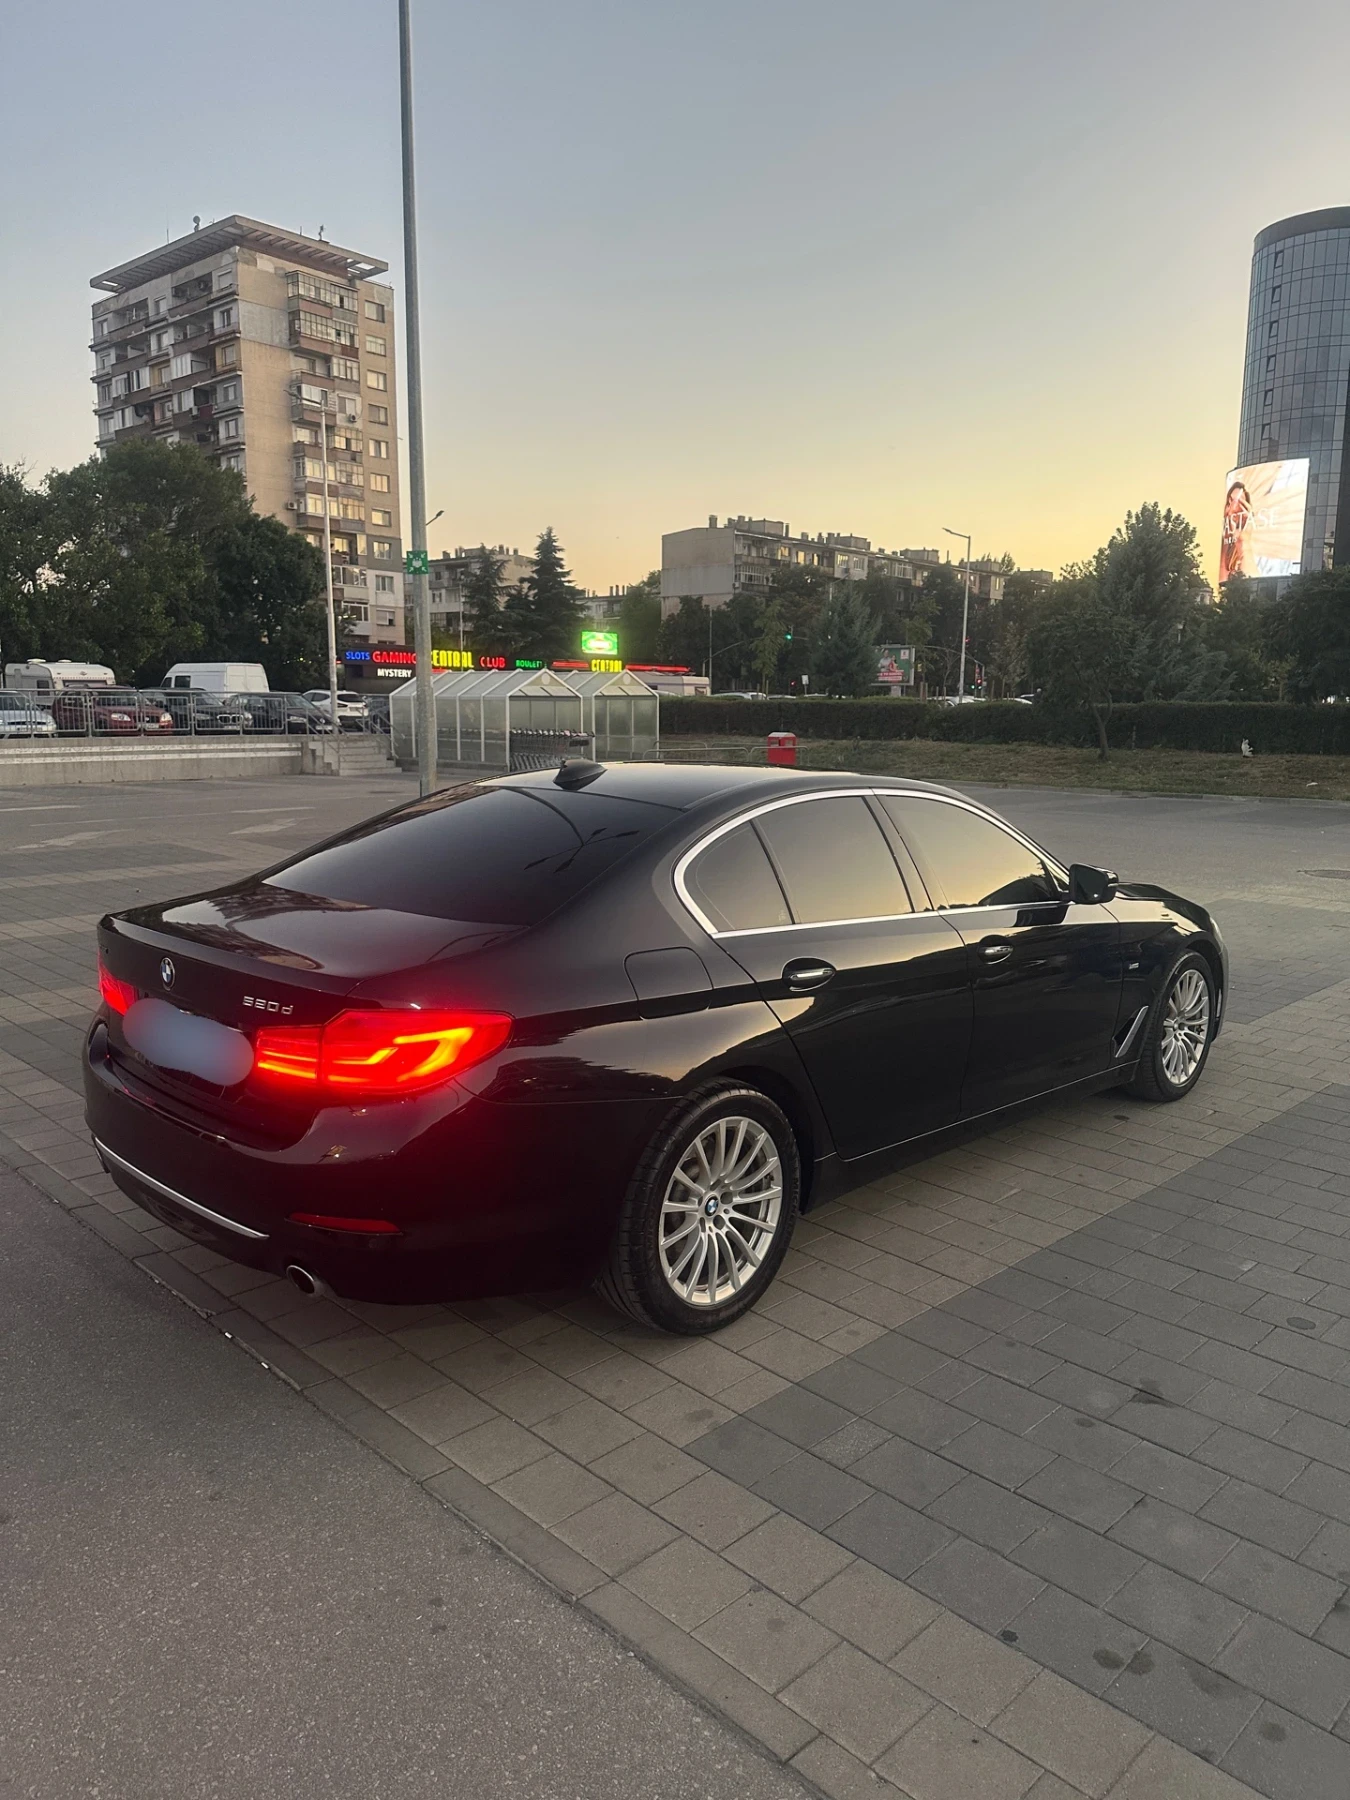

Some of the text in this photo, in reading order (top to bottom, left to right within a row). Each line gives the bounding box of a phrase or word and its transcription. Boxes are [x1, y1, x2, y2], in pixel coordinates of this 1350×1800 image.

[346, 651, 370, 660] SLOTS
[431, 650, 474, 667] ENTRAL
[480, 656, 505, 667] CLUB
[377, 668, 412, 677] MYSTERY
[243, 995, 293, 1014] 520d
